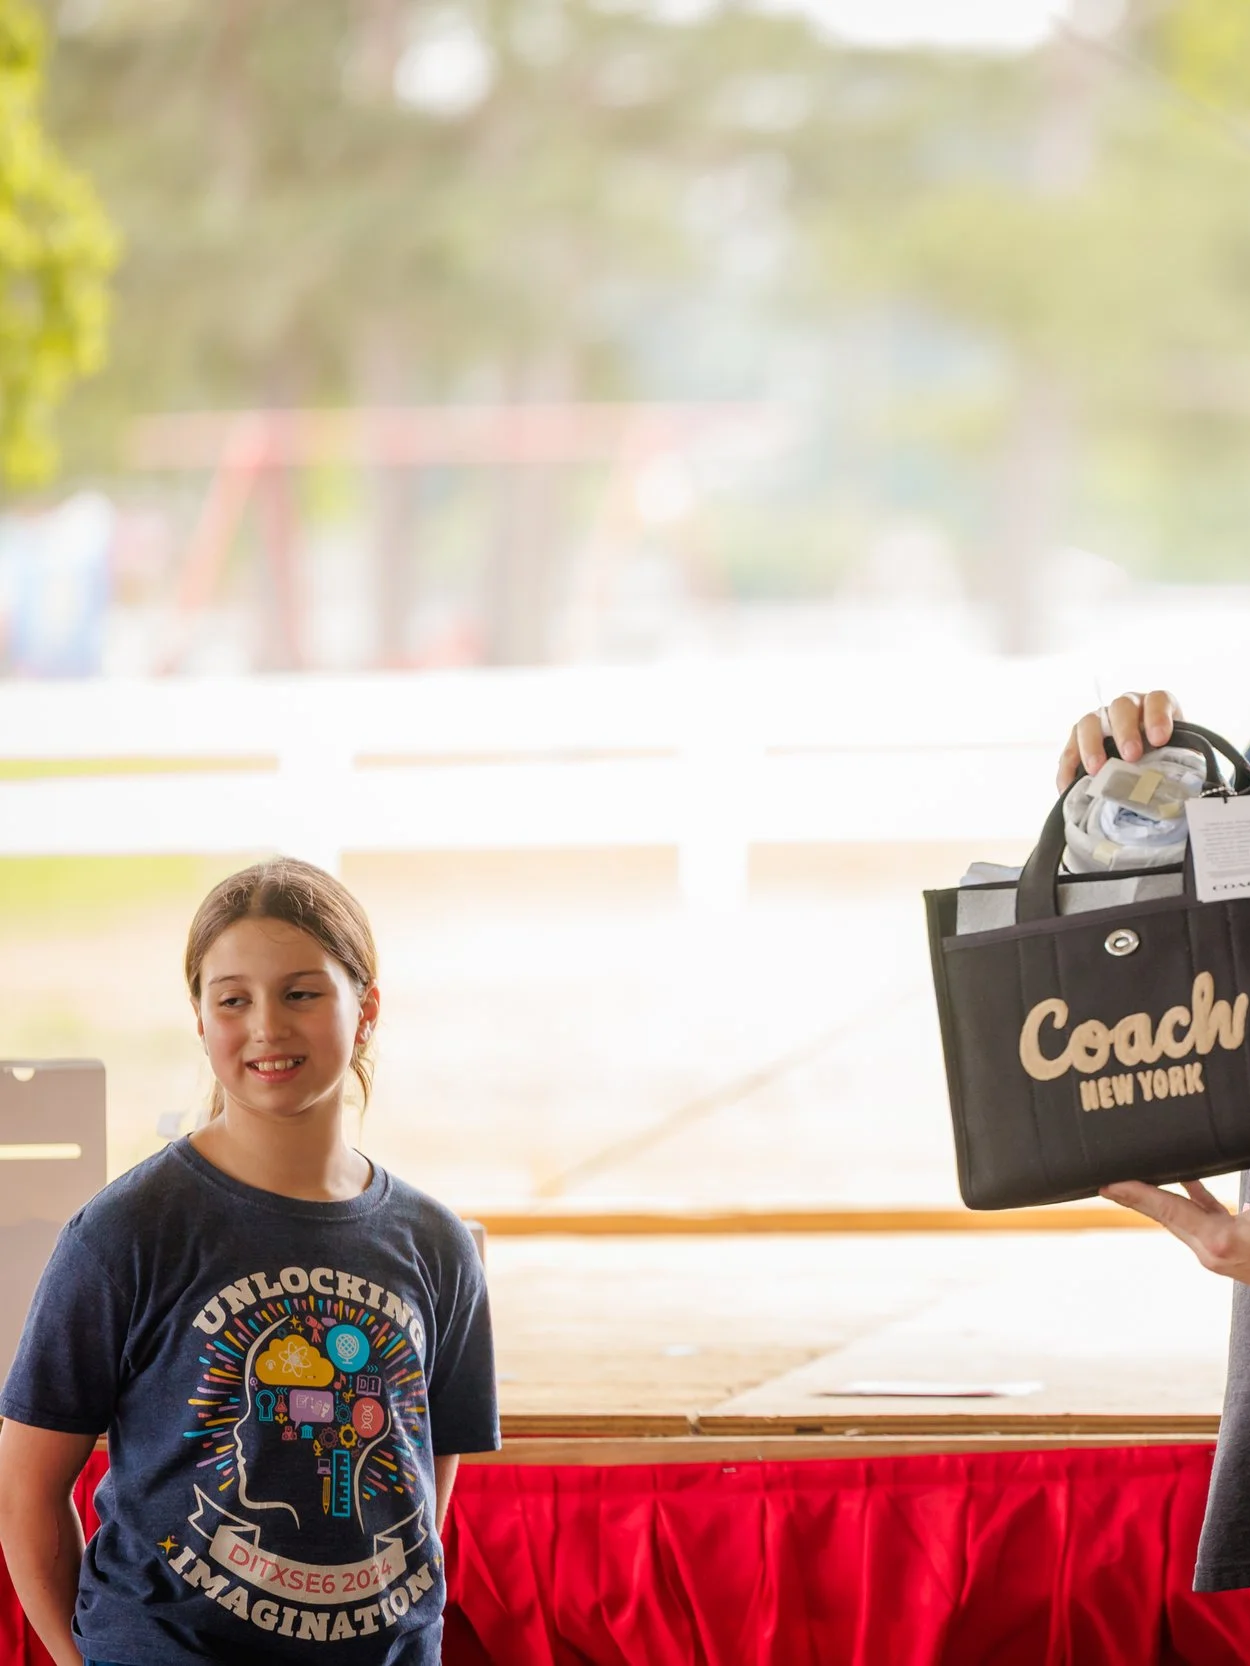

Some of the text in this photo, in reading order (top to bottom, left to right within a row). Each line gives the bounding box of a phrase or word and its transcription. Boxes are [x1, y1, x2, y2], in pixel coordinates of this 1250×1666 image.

[1019, 971, 1249, 1081] Coach
[1080, 1062, 1205, 1112] NEW YORK
[193, 1266, 424, 1352] UNLOCKING
[168, 1547, 436, 1642] IMAGINATION
[228, 1543, 392, 1595] DITXSE6 2024
